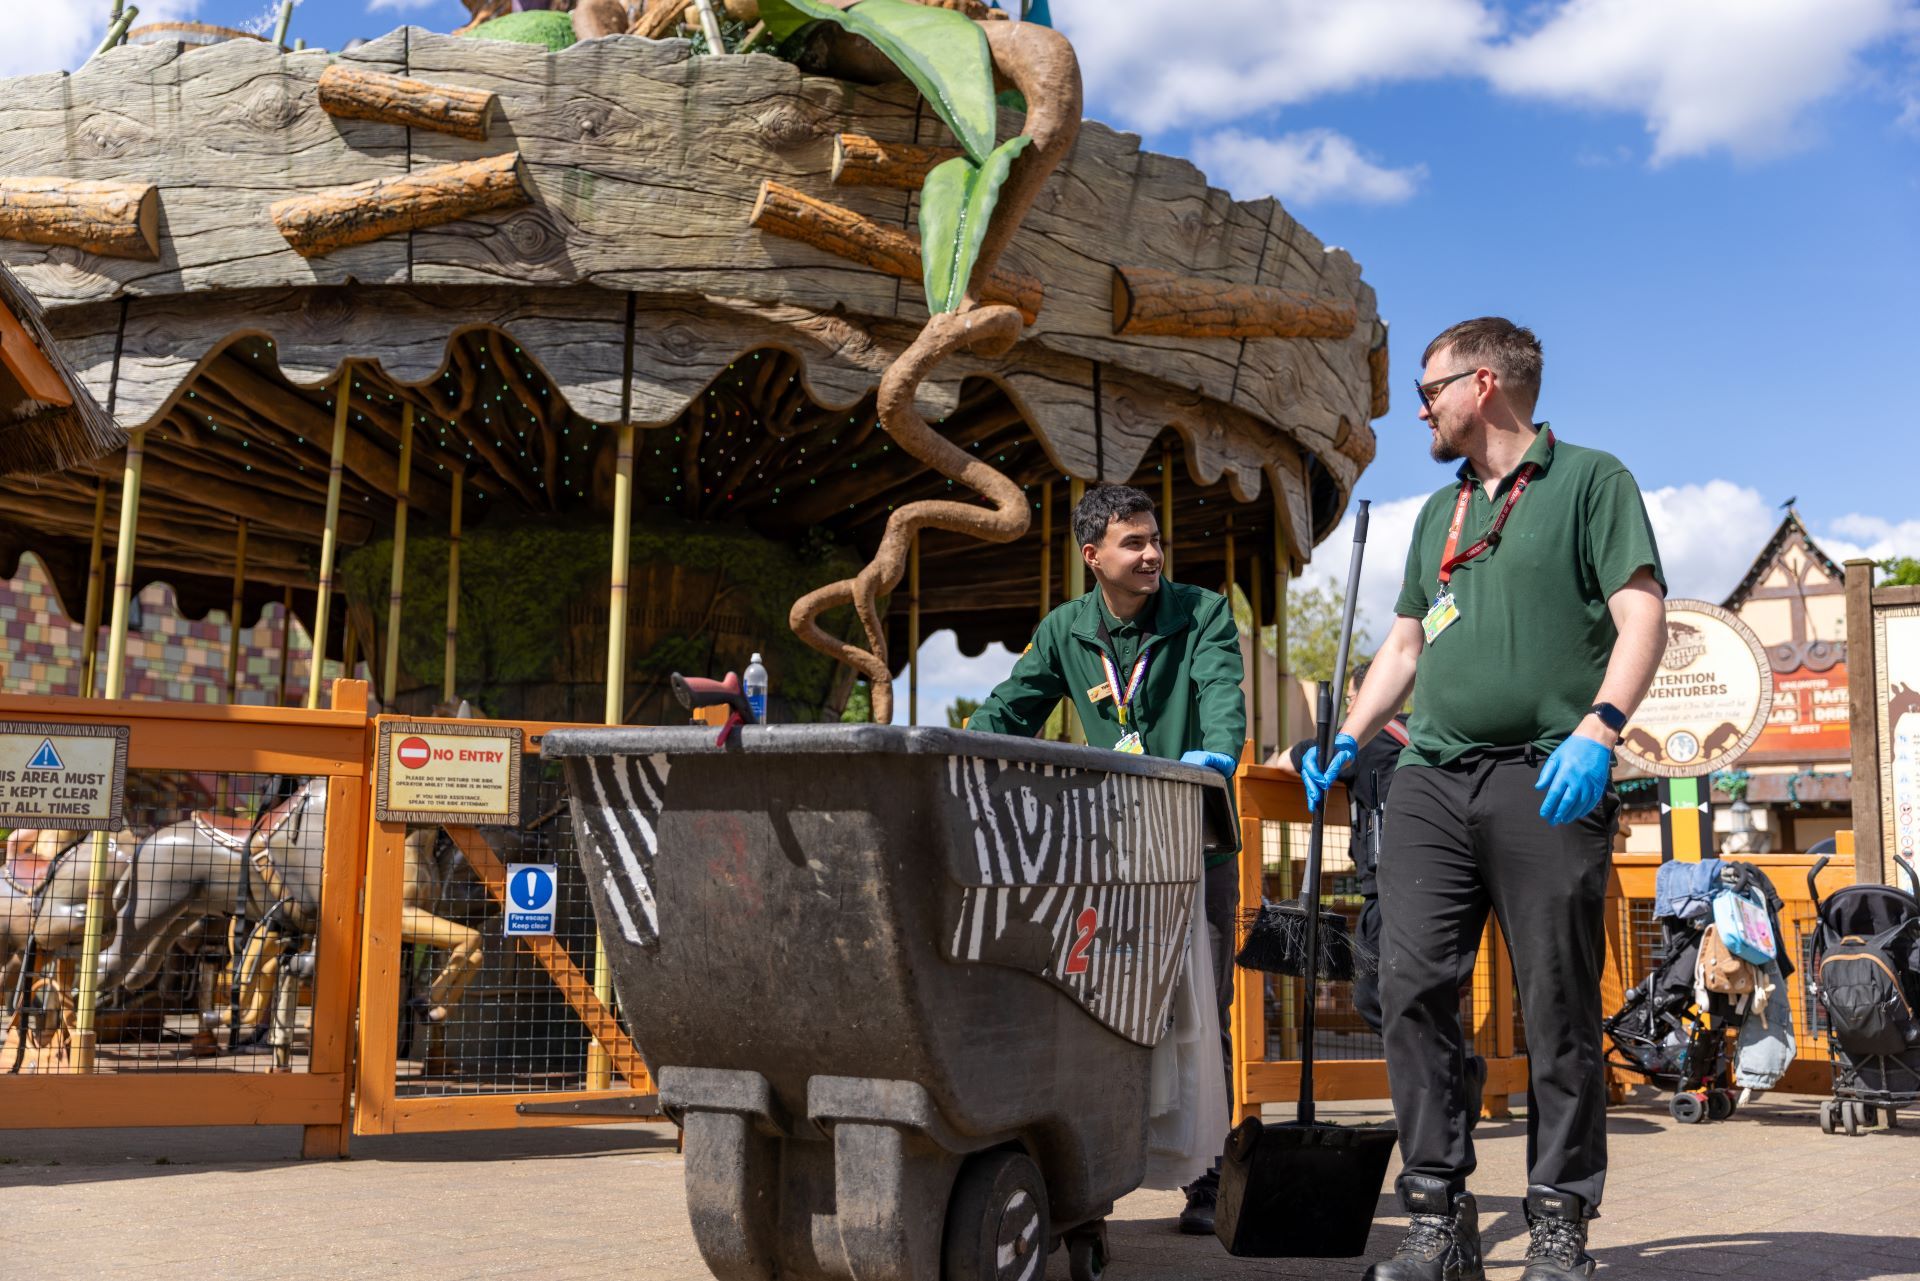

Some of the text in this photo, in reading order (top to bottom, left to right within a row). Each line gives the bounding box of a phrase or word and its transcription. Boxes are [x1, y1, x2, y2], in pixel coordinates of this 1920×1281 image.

[1652, 672, 1715, 686] TTENTION
[1645, 684, 1727, 698] VENTURERS
[433, 749, 504, 763] NO ENTRY
[0, 770, 106, 785] IS AREA MUST
[10, 786, 47, 798] KEPT
[53, 788, 98, 800] CLEAR
[0, 802, 90, 815] T ALL TIMES
[1064, 906, 1098, 975] 2
